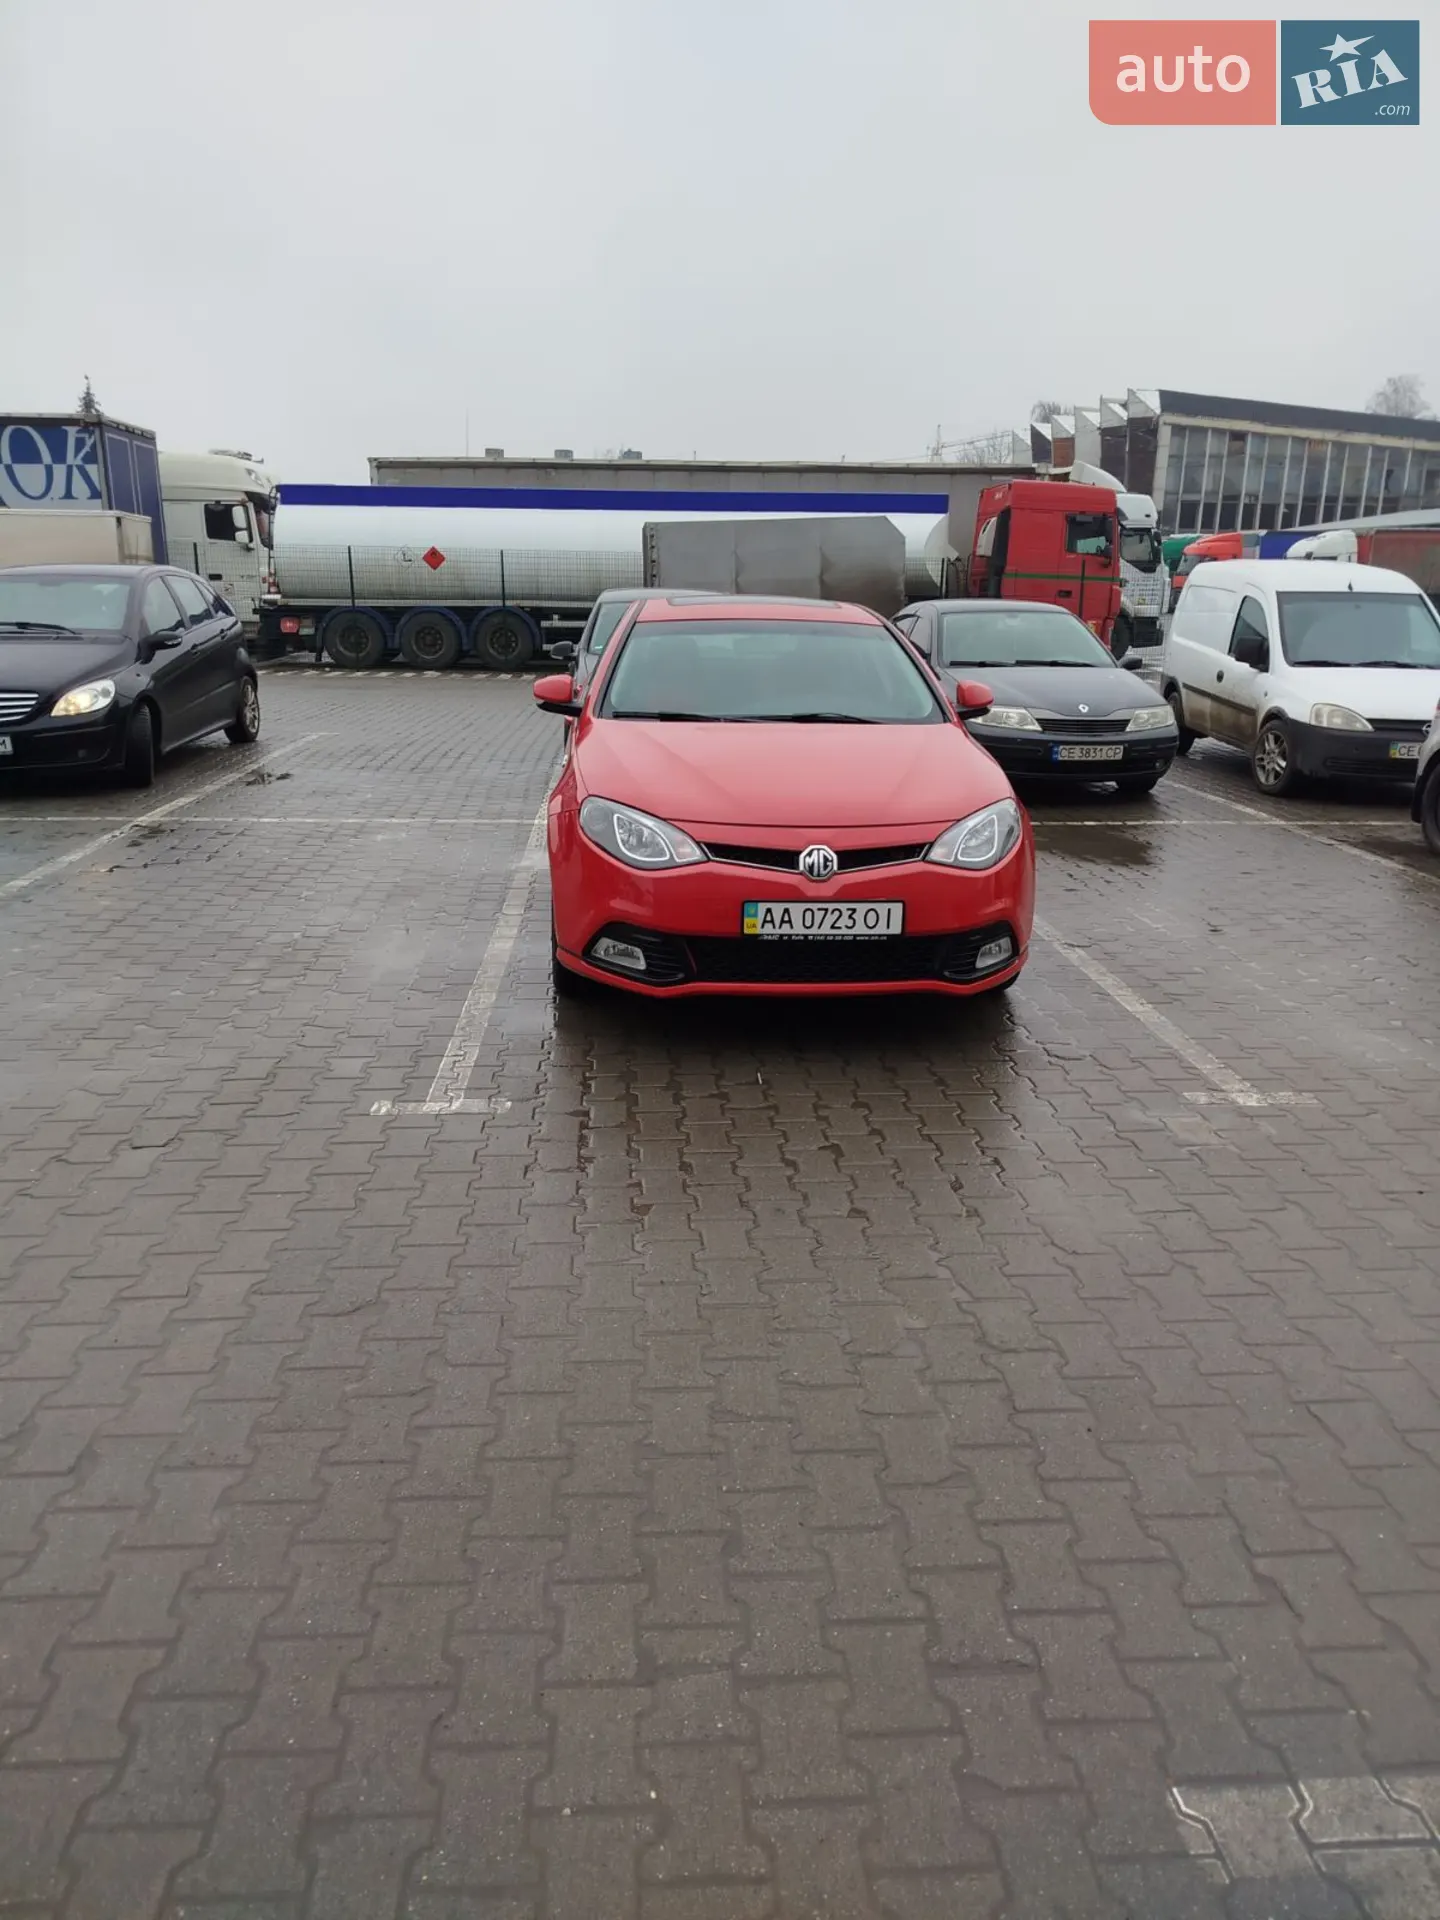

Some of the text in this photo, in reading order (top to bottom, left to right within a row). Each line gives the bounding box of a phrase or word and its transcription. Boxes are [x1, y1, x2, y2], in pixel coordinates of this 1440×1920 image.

[1060, 747, 1121, 759] CE 3831 CP
[803, 848, 833, 878] MG
[760, 907, 892, 930] AA 0723 OI
